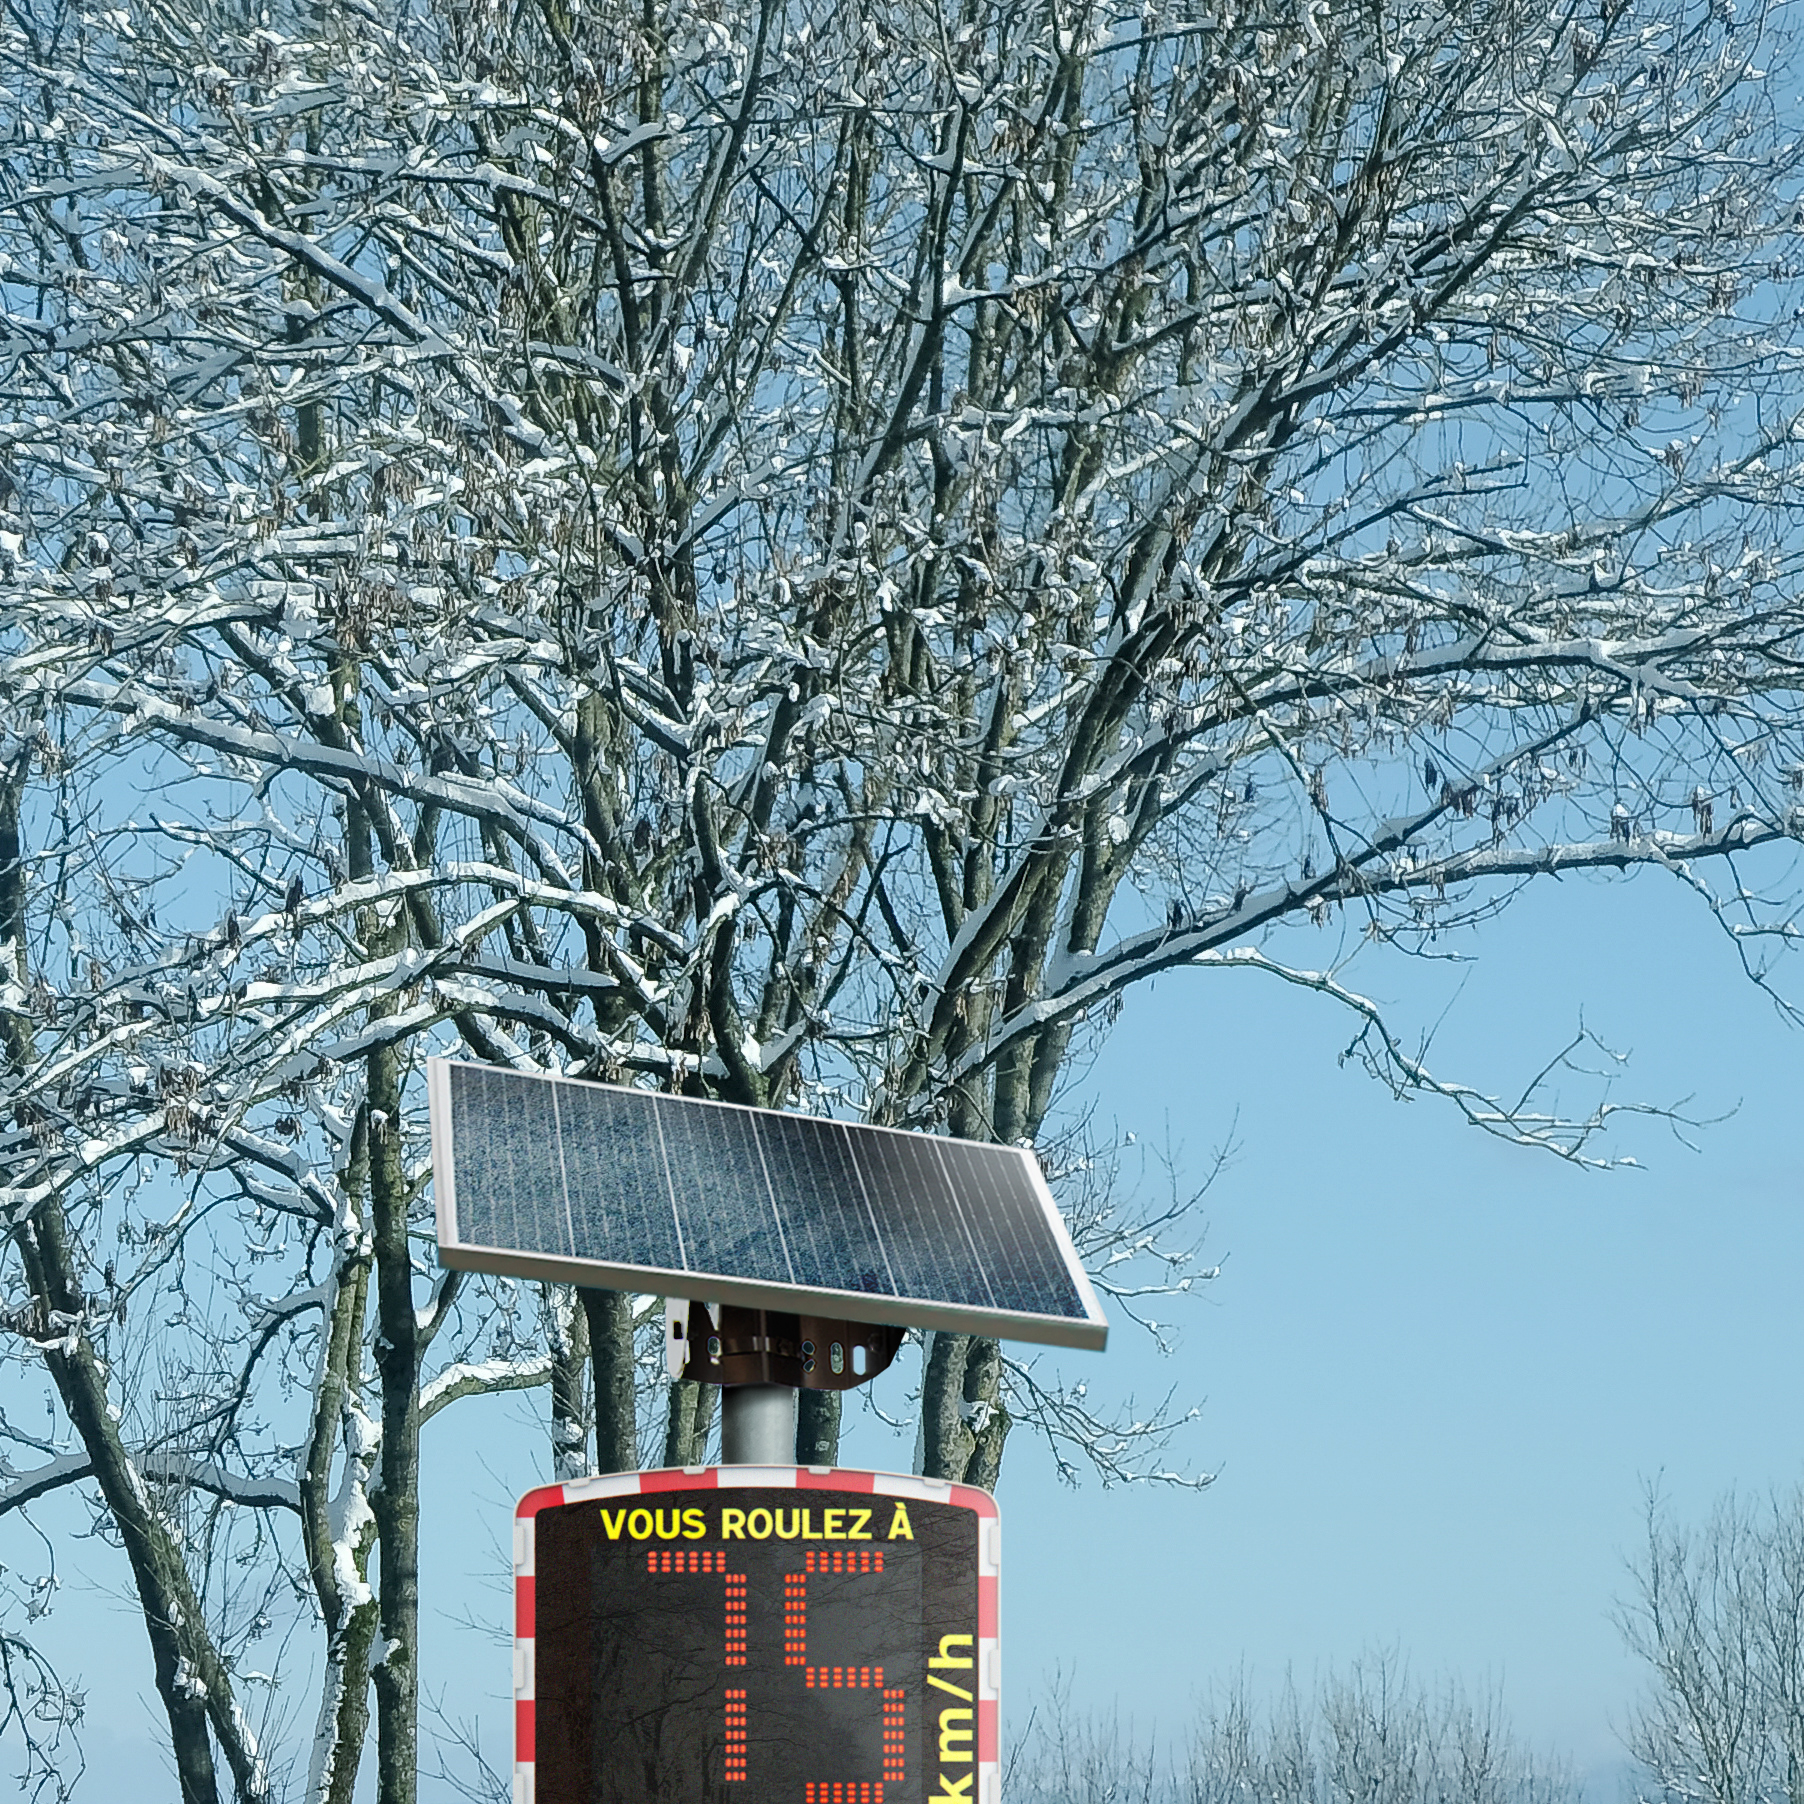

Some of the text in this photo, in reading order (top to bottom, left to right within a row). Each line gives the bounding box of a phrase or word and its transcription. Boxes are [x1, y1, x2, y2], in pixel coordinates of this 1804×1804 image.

[599, 1501, 915, 1540] VOUS ROULEZ À
[647, 1551, 905, 1804] 75
